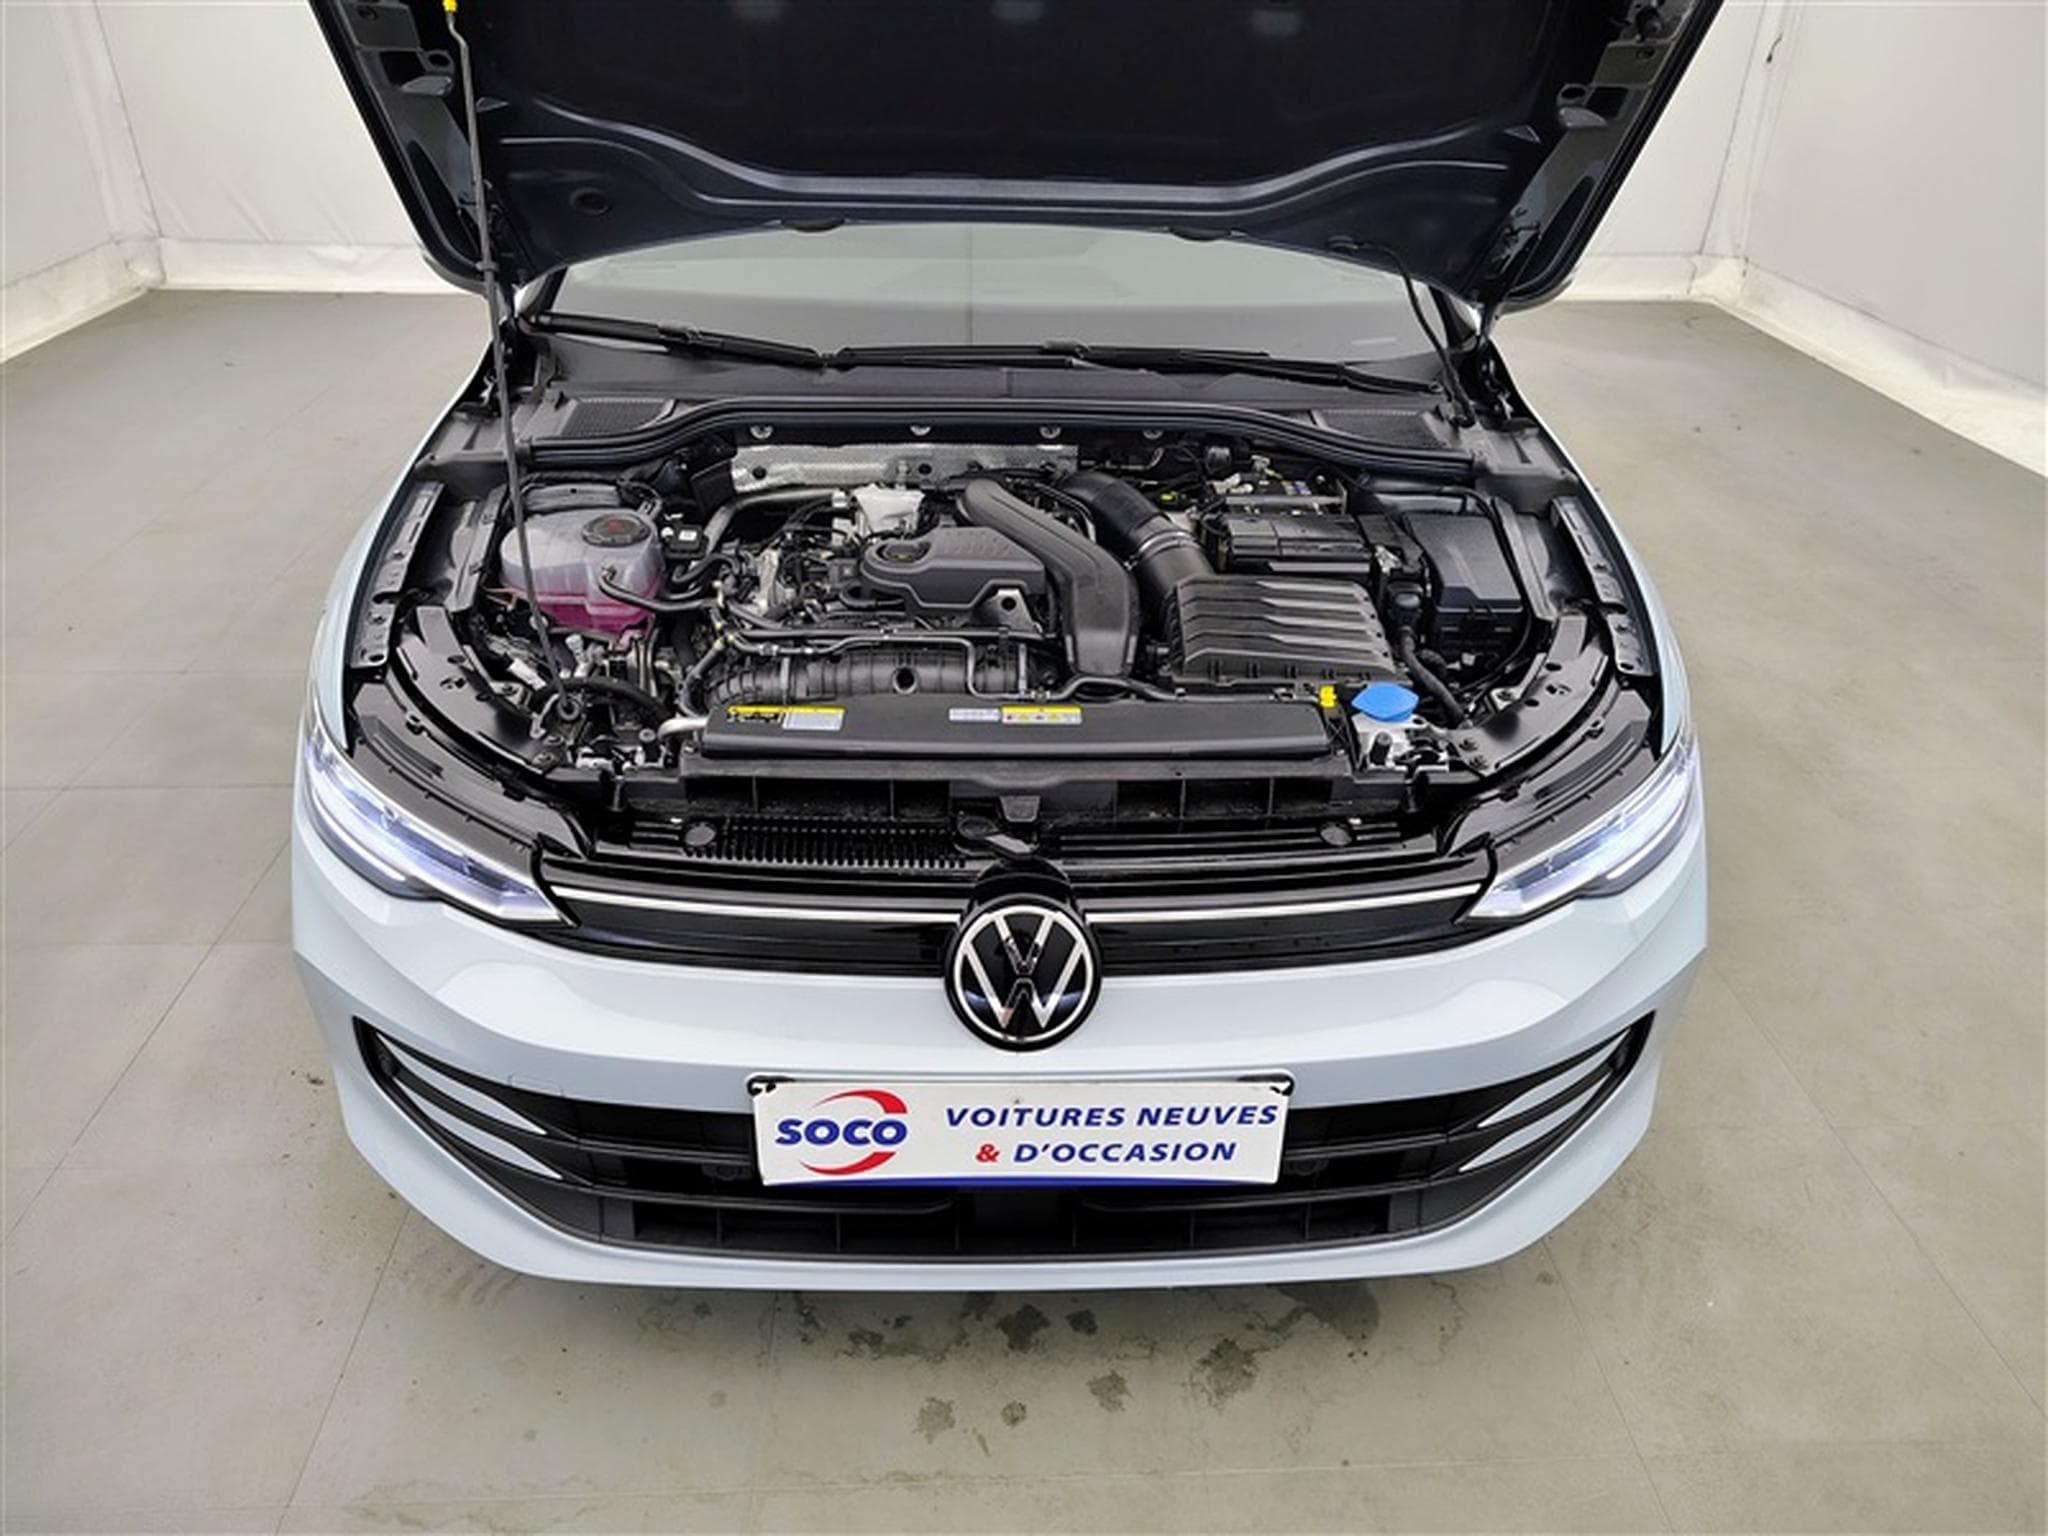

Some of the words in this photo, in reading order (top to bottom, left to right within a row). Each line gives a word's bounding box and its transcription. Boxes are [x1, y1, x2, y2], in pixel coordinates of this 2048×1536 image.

[946, 1106, 1126, 1127] VOITURES
[1137, 1105, 1278, 1126] NEUVES
[775, 1119, 907, 1145] SOCO
[975, 1143, 1000, 1163] &
[1013, 1142, 1236, 1163] D'OCCASION
